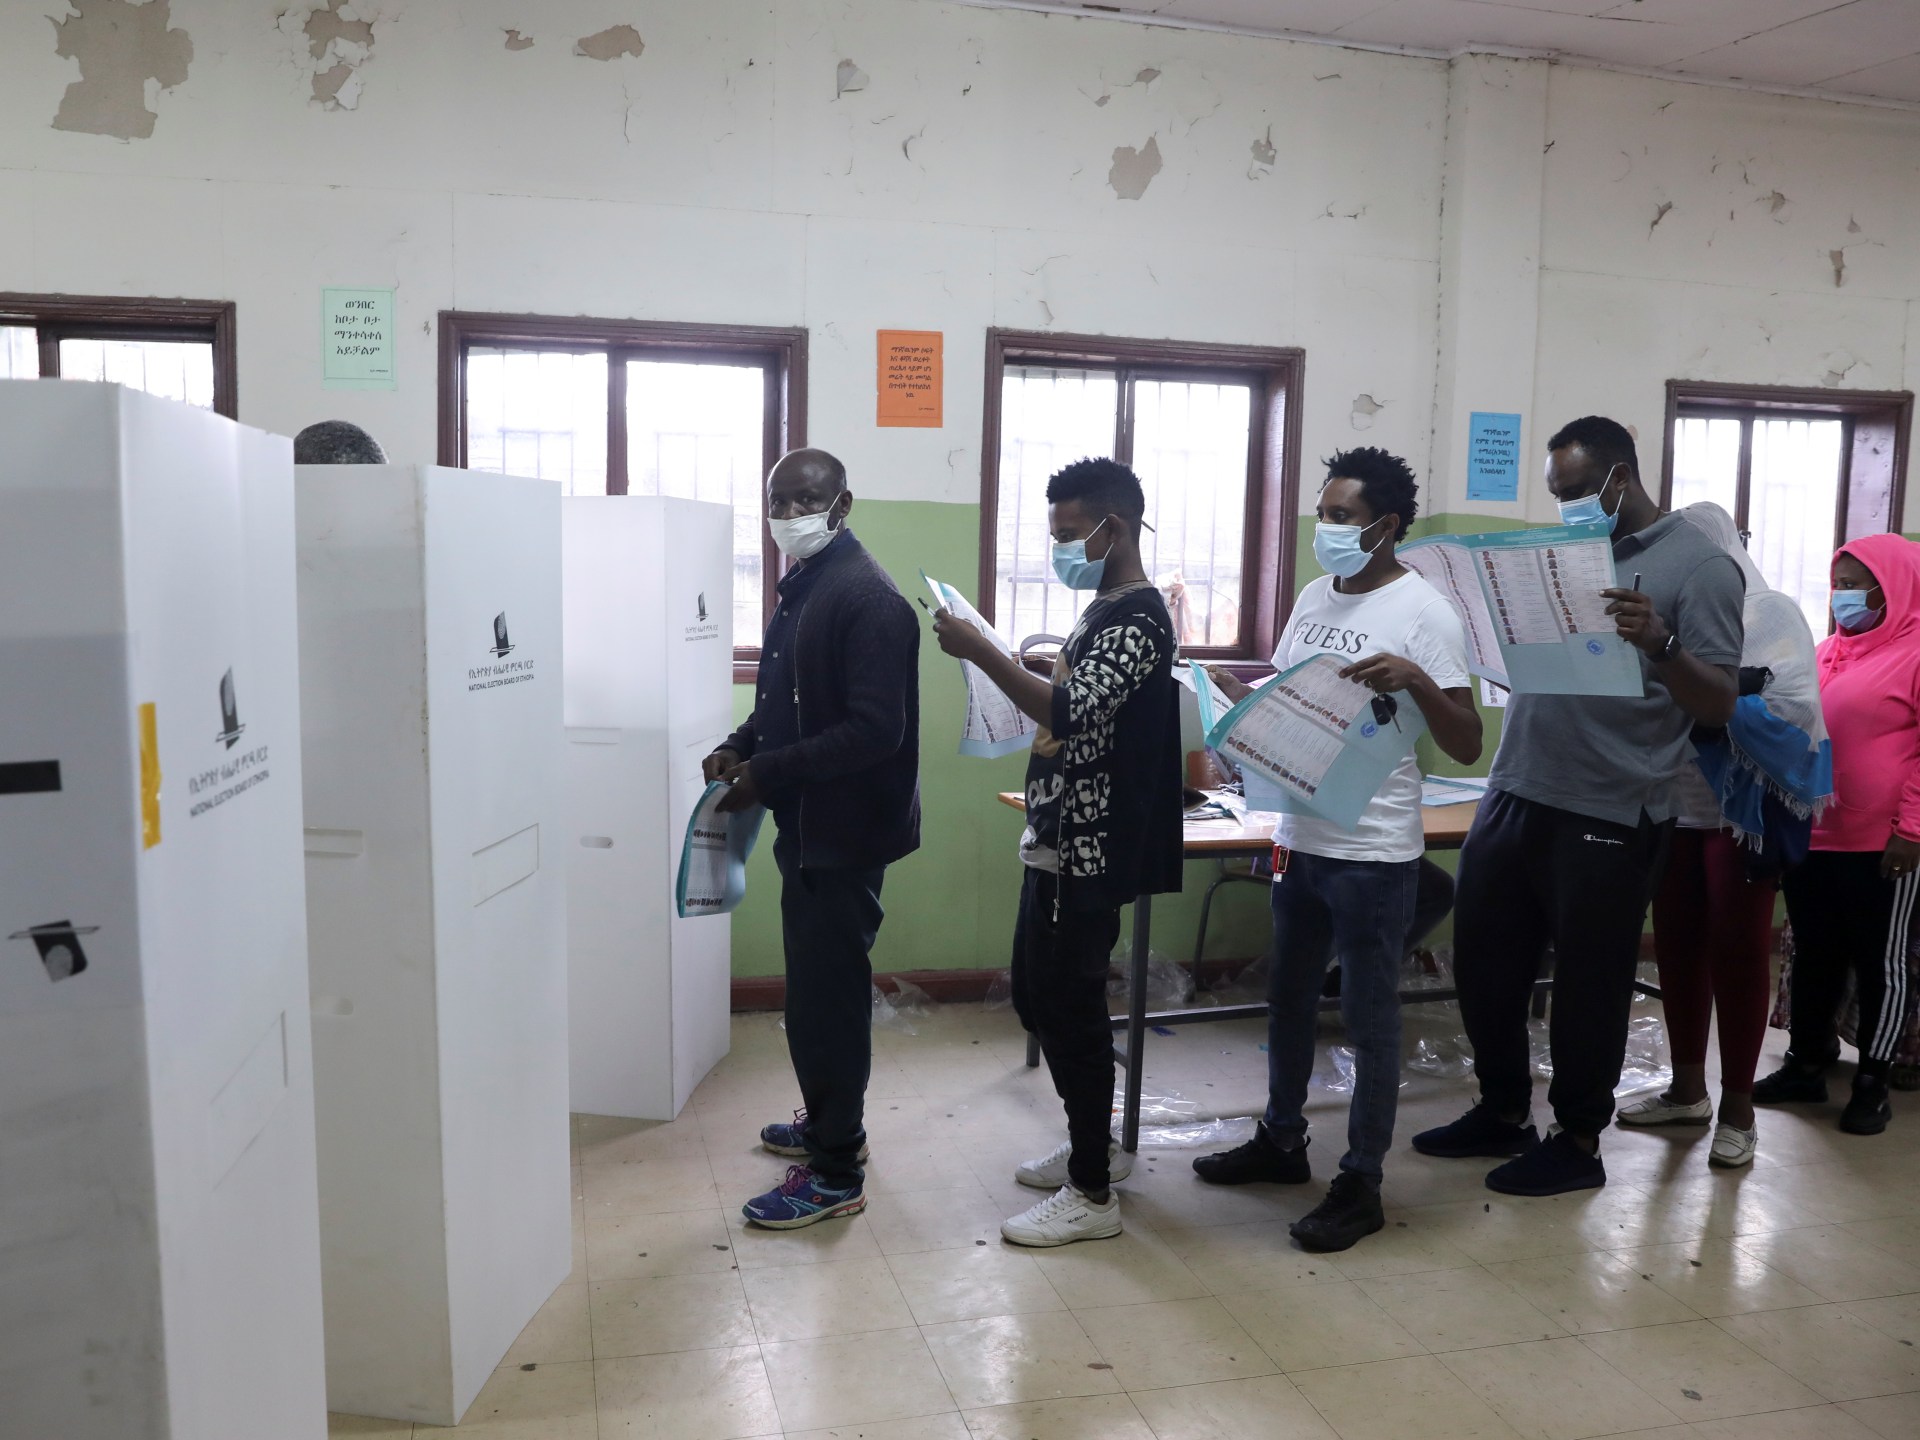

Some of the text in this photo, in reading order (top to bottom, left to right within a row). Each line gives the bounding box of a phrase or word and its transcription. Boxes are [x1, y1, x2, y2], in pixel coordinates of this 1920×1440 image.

[345, 300, 375, 310] ወንበር
[335, 314, 381, 326] ከቦታ ቦታ
[336, 345, 380, 356] አይቻልም
[1294, 622, 1369, 654] GUESS
[468, 682, 487, 692] NATIONAL
[488, 679, 503, 689] ELECTION
[504, 676, 515, 686] BOARD
[189, 798, 214, 819] NATIONAL
